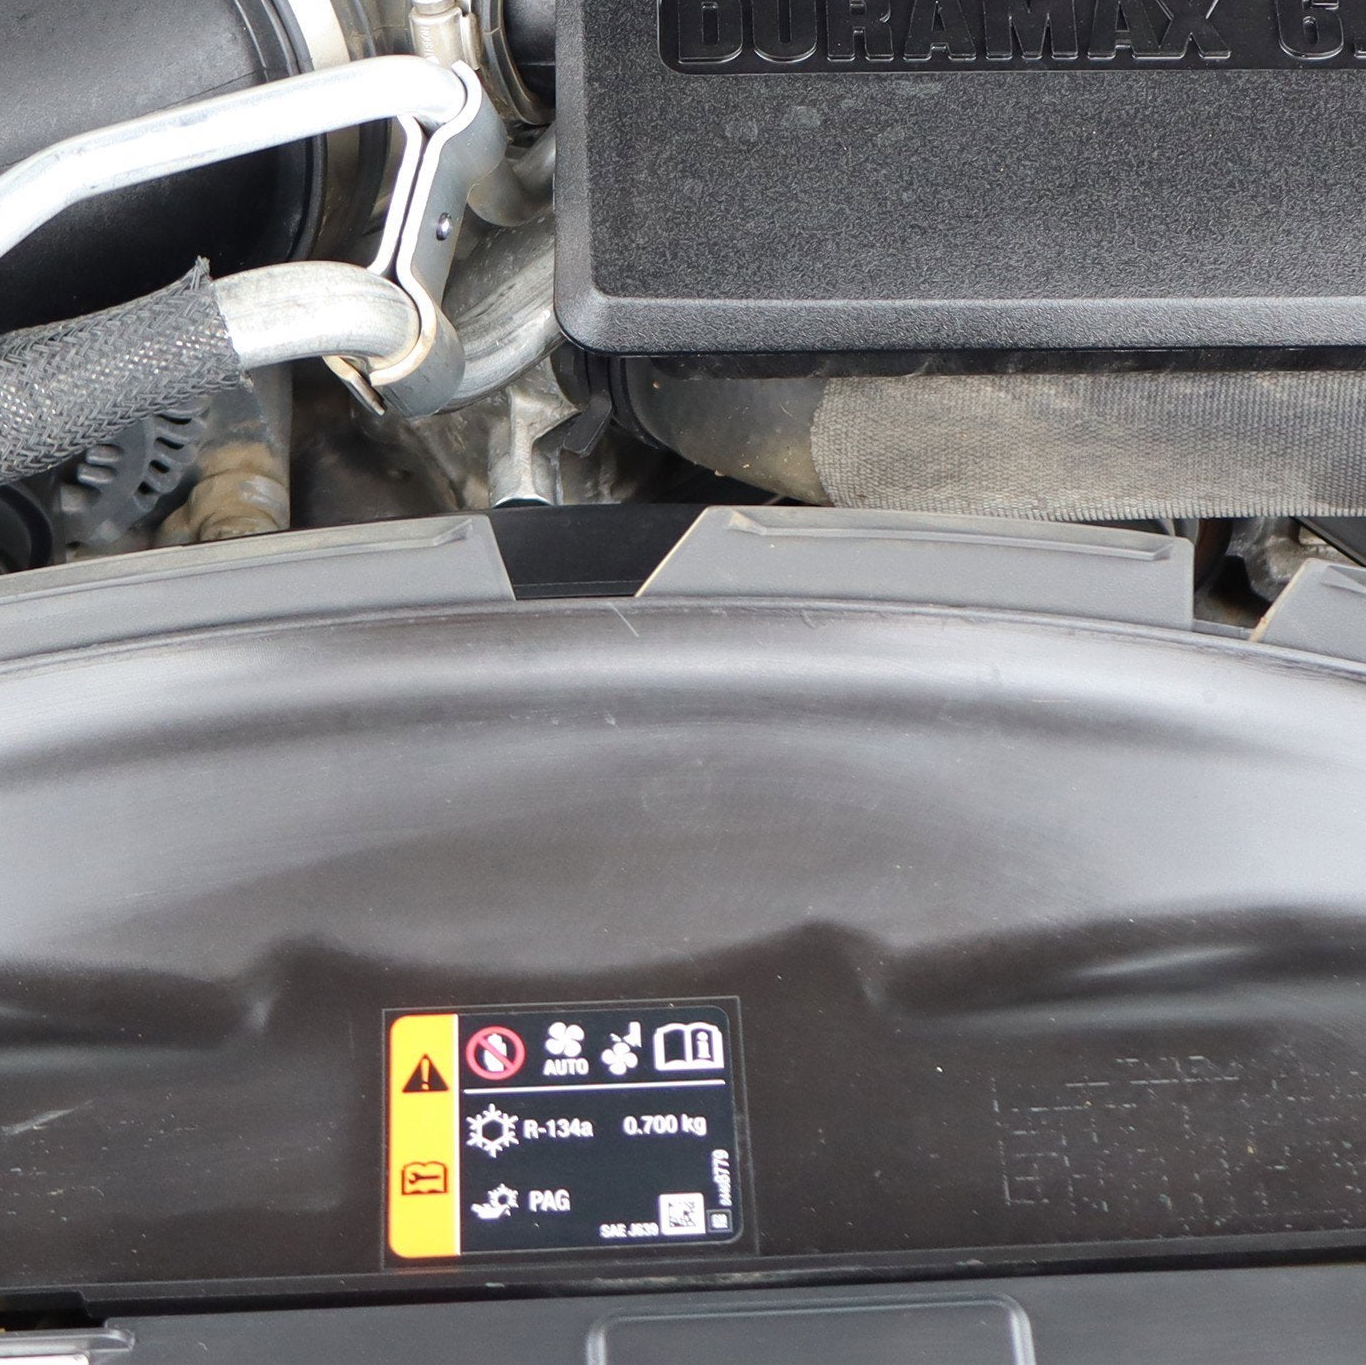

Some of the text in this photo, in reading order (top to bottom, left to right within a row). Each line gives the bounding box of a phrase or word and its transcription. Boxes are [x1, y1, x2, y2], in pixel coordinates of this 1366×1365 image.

[543, 1058, 589, 1076] AUTO
[523, 1113, 707, 1139] R-134a 0.700 kg
[528, 1189, 571, 1212] PAG
